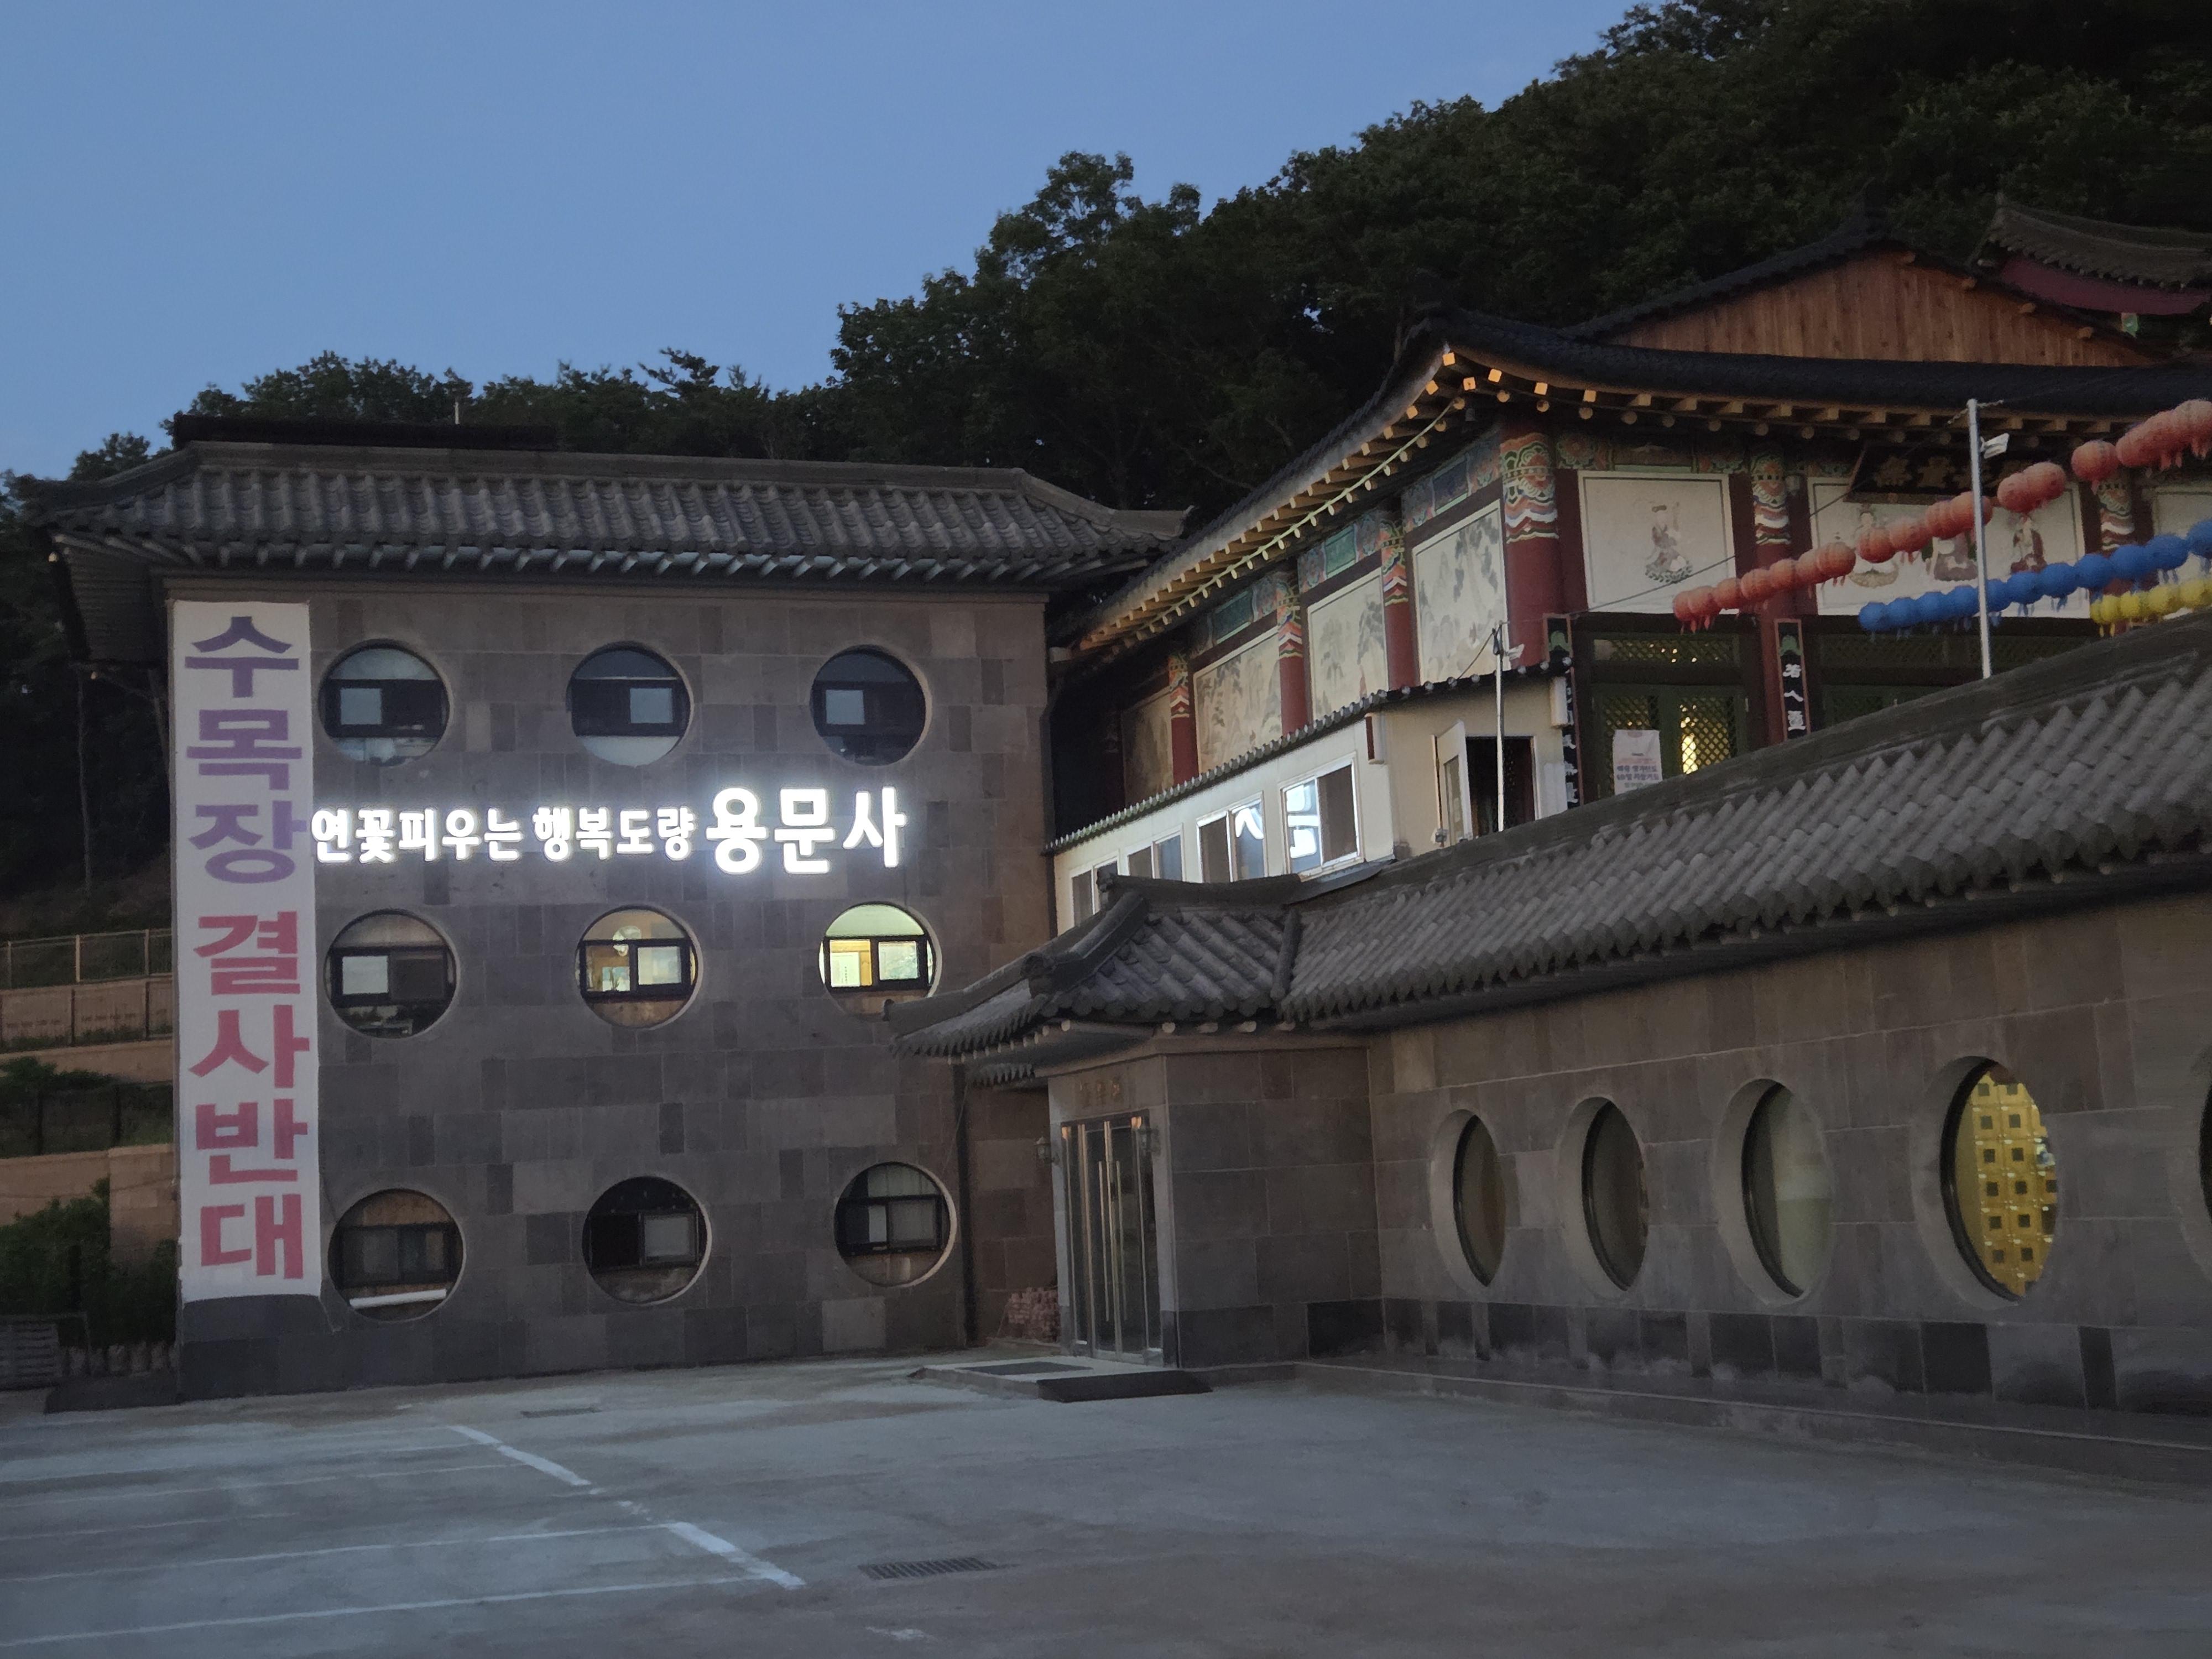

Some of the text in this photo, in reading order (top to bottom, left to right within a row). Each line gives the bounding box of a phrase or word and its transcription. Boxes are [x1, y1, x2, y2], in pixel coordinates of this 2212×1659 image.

[184, 616, 310, 1279] 수목장 결사반대
[532, 807, 696, 862] 행복도량
[706, 786, 907, 874] 용문사
